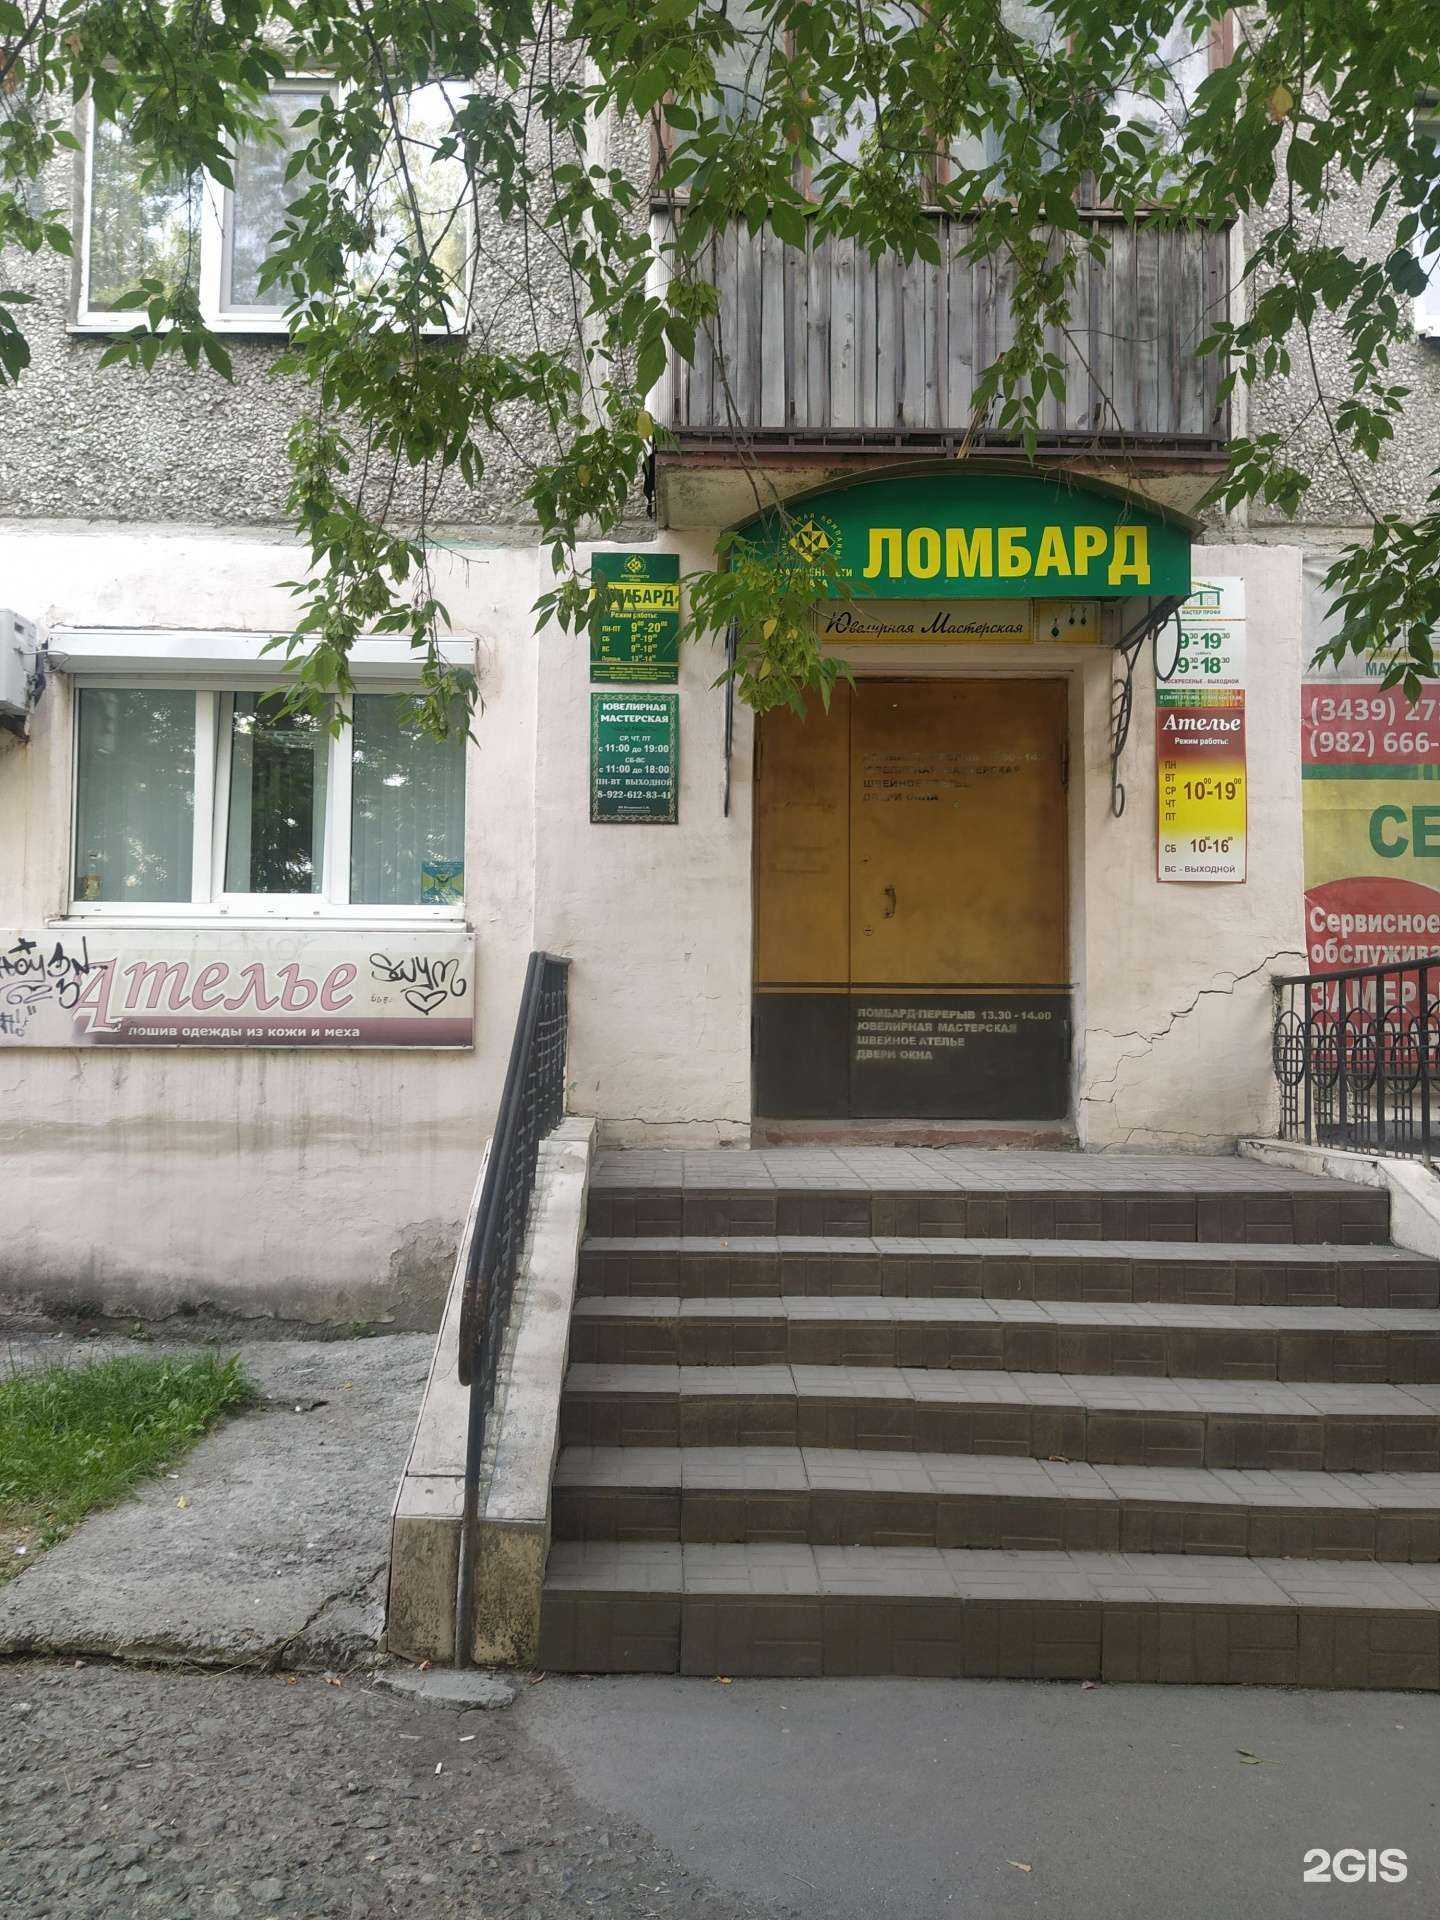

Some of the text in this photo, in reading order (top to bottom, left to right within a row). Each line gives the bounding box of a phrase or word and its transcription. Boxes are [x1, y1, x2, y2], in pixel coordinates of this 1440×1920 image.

[863, 525, 1151, 586] ЛОМБАРД
[600, 589, 674, 606] МБАРД
[920, 611, 1025, 637] Мастерская
[602, 702, 667, 711] ЮВЕЛИРНАЯ
[1311, 697, 1440, 726] (3439) 27
[600, 714, 669, 723] МАСТЕРСКАЯ
[1163, 713, 1241, 731] Ателье
[1174, 737, 1229, 746] Режим работы:
[1310, 730, 1376, 757] (982)
[604, 744, 630, 752] 11:00
[643, 744, 669, 753] 19:00
[605, 765, 631, 773] 11:00
[644, 765, 670, 774] 18:00
[1164, 760, 1177, 769] ПН
[1164, 773, 1176, 782] ВТ
[1164, 786, 1177, 795] СР
[1164, 799, 1177, 808] ЧТ
[1164, 812, 1177, 821] ПТ
[1164, 843, 1177, 853] СБ
[1164, 865, 1177, 873] ВС
[1184, 864, 1236, 873] ВЫХОДНОЙ
[1310, 906, 1440, 939] Сервисное
[73, 957, 358, 1031] Ателье
[981, 1010, 1011, 1020] 13.30
[1021, 1010, 1052, 1020] 14.00
[182, 1026, 242, 1038] одежды
[246, 1027, 263, 1036] из
[267, 1027, 306, 1037] кожи
[311, 1027, 320, 1037] и
[324, 1027, 361, 1037] меха
[856, 1022, 1017, 1033] ЮВЕЛИРНАЯ МАСТЕРСКАЯ
[856, 1049, 897, 1060] ДВЕРИ
